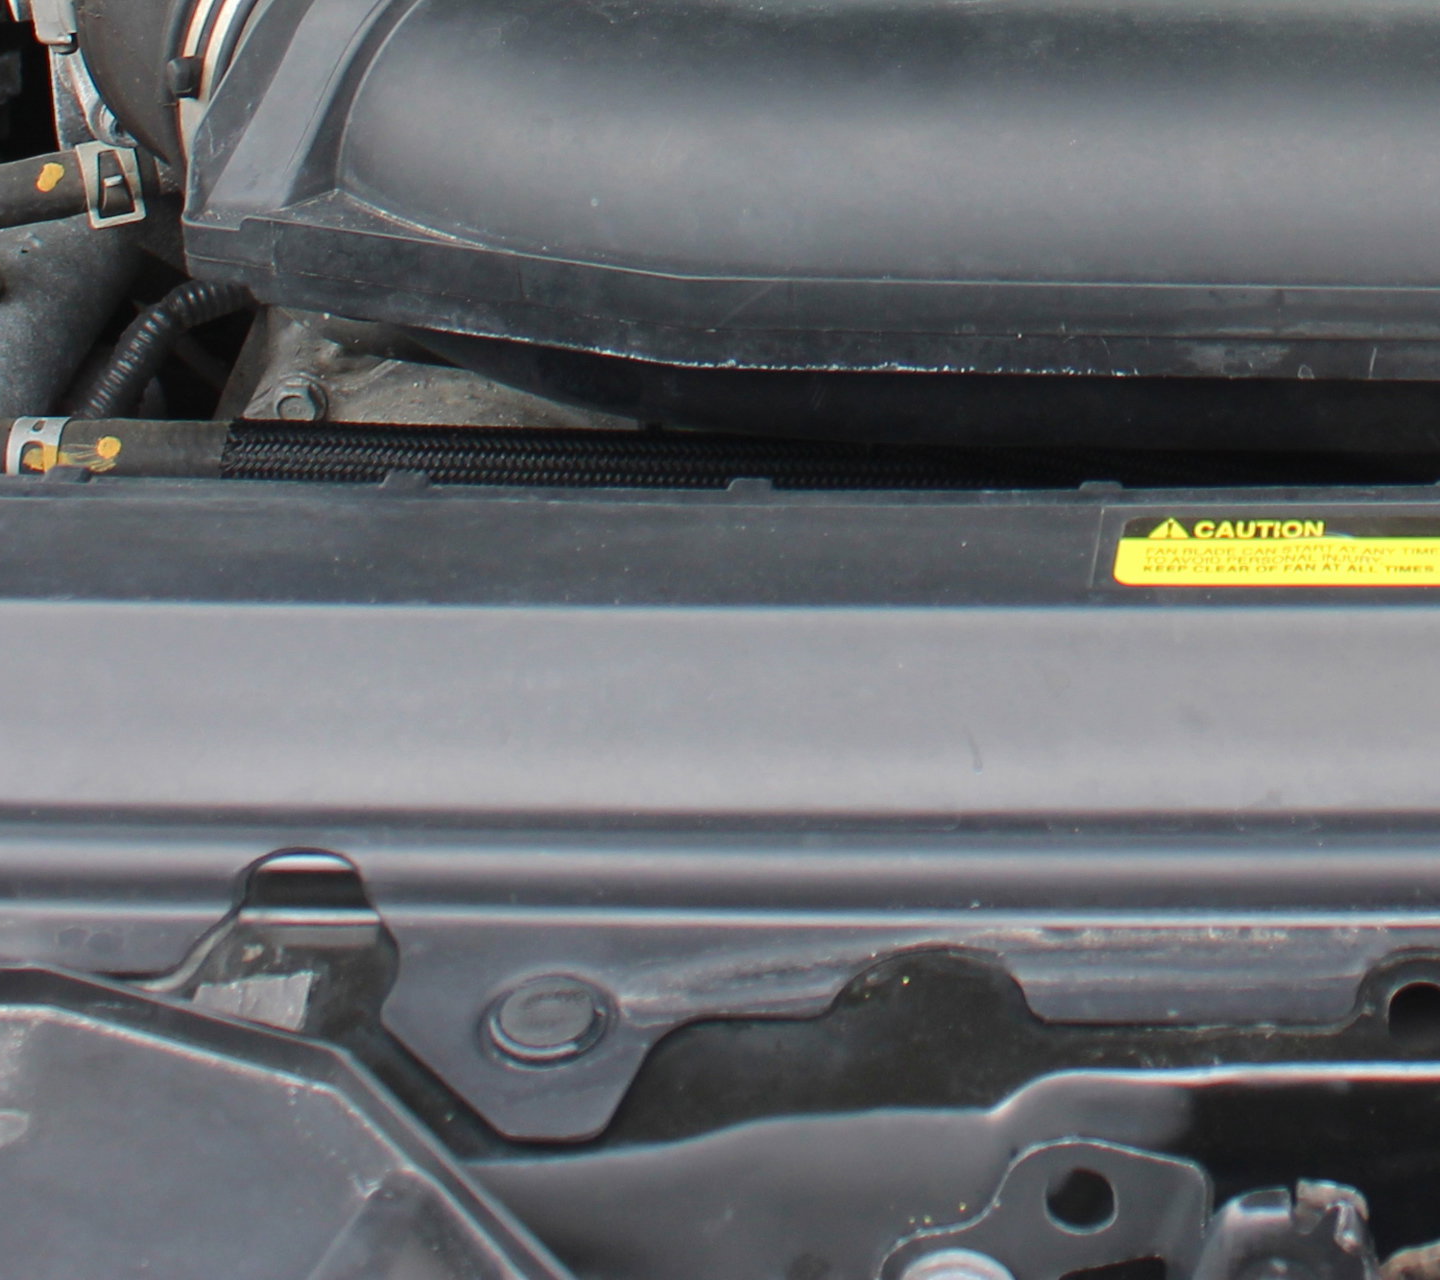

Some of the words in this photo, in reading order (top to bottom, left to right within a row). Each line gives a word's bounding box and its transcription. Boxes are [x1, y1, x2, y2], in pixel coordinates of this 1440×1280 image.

[1193, 520, 1325, 539] CAUTION
[1145, 547, 1177, 556] FAN
[1182, 547, 1235, 556] BLADE
[1241, 547, 1276, 555] CAN
[1281, 544, 1334, 555] START
[1339, 545, 1357, 555] AT
[1362, 546, 1395, 556] ANY
[1402, 546, 1440, 555] TIME
[1145, 556, 1168, 565] TO
[1172, 556, 1221, 565] AVOID
[1226, 554, 1314, 564] PERSONAL
[1143, 565, 1188, 573] KEEP
[1193, 565, 1250, 573] CLEAR
[1259, 565, 1278, 573] OF
[1283, 564, 1316, 572] FAN
[1321, 564, 1341, 572] AT
[1346, 564, 1377, 572] ALL
